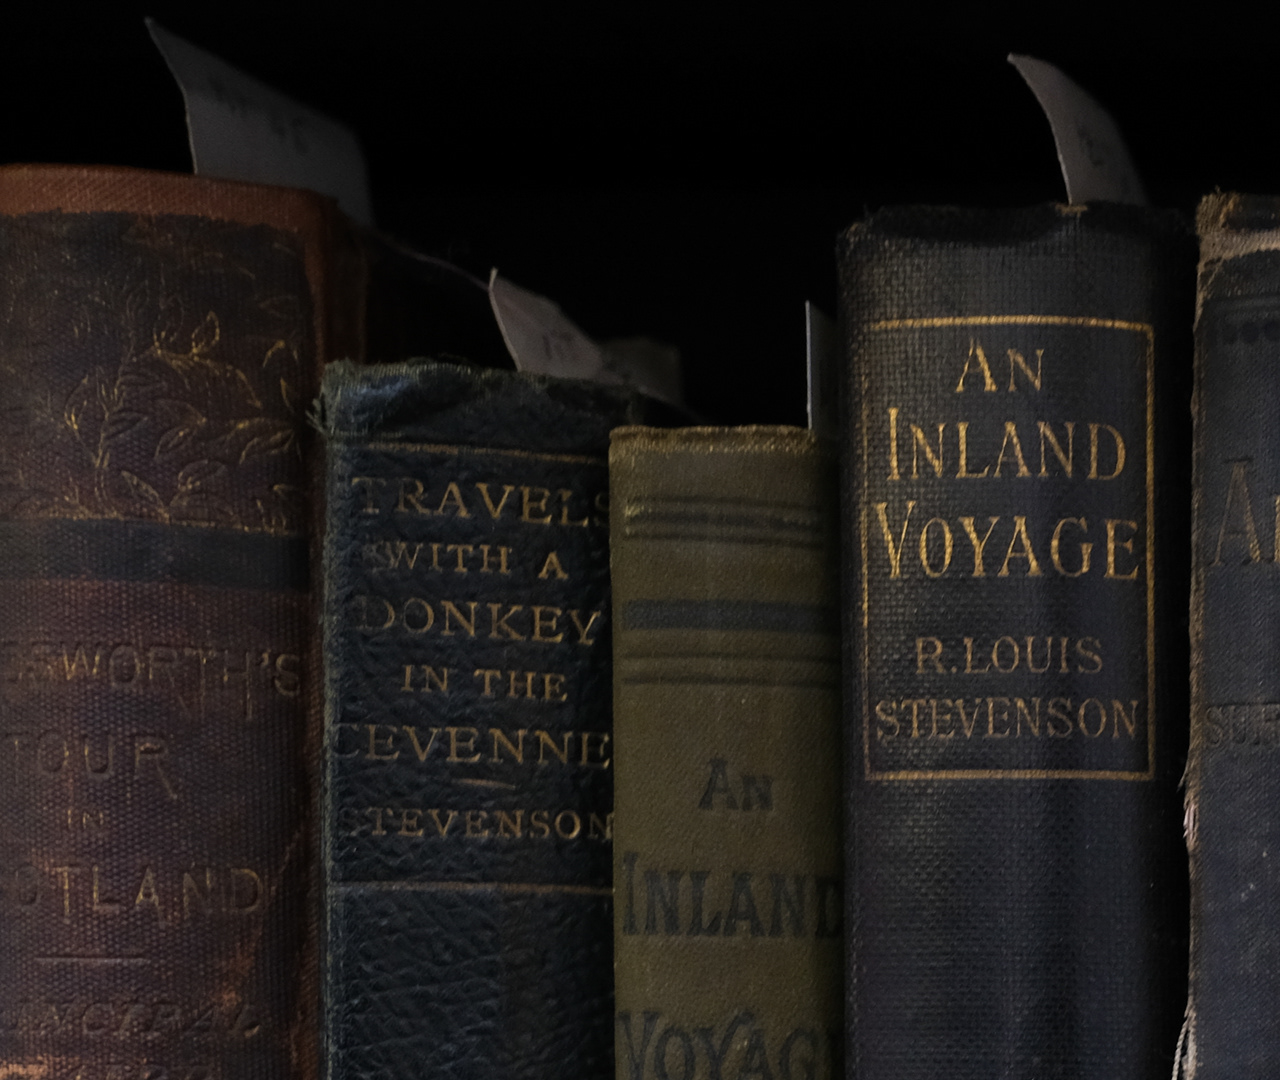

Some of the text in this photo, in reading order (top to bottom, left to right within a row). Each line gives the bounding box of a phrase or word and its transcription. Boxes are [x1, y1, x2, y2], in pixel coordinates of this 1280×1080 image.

[955, 339, 1044, 393] AN
[885, 406, 1127, 482] INLAND
[366, 540, 569, 581] WITH A
[874, 500, 1140, 581] VOYAGE
[352, 596, 602, 645] DONKEY
[401, 664, 568, 702] IN THE
[874, 697, 1140, 742] STEVENSON
